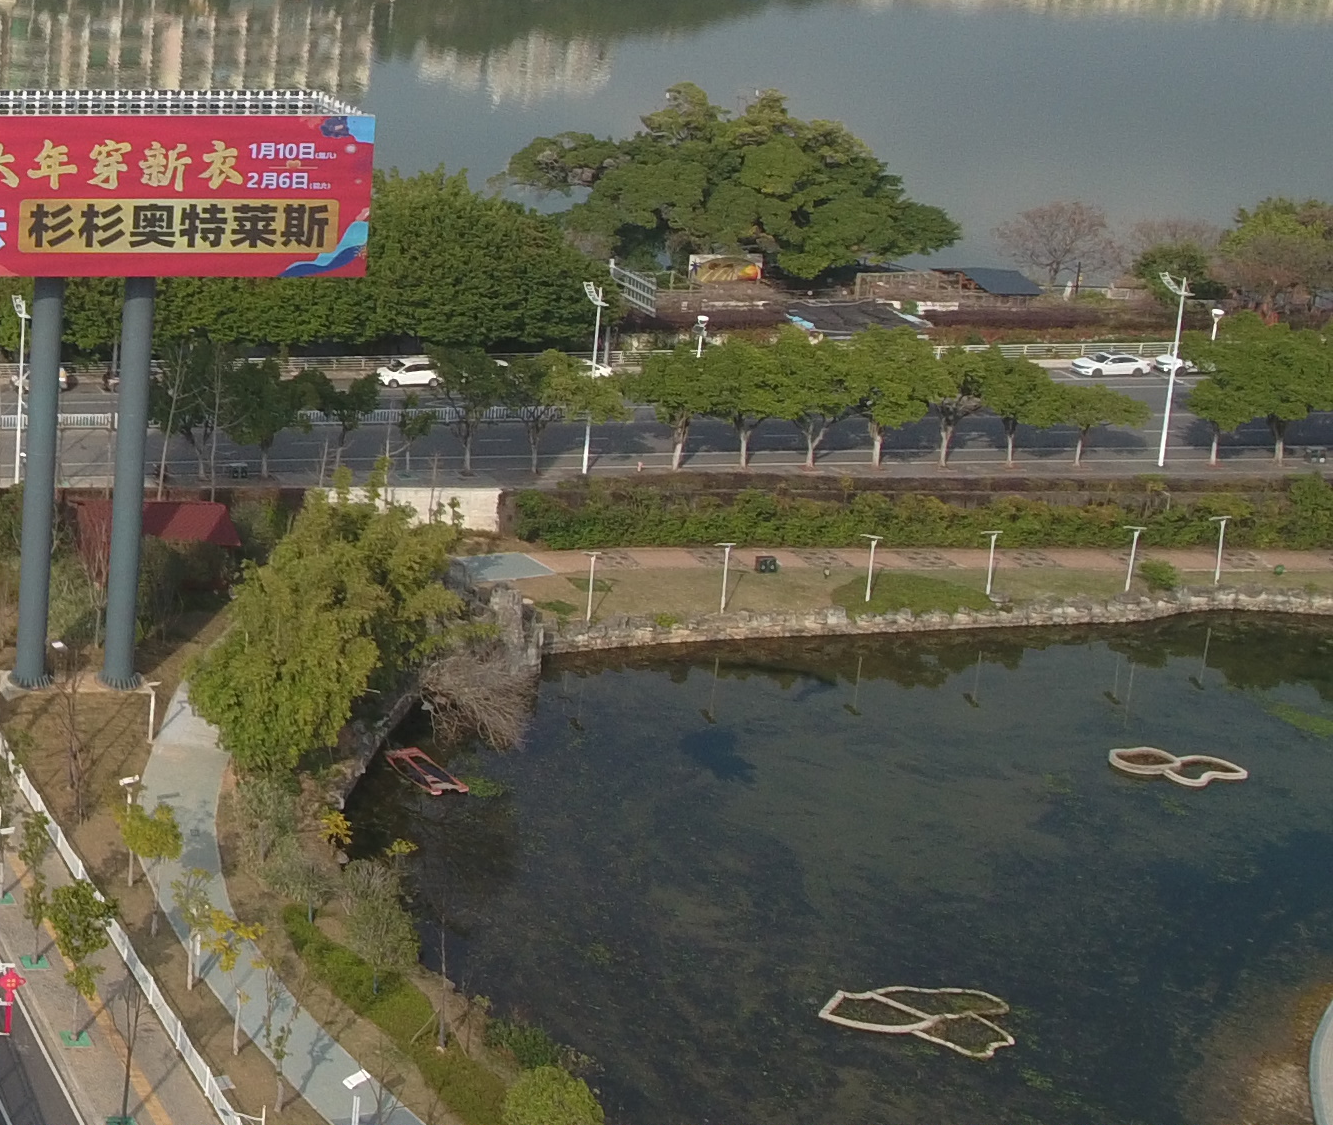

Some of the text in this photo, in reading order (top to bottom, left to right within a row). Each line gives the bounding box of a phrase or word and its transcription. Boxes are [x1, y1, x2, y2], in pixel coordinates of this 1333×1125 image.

[248, 142, 315, 159] 1月10日
[247, 172, 308, 189] 2月6日
[29, 204, 330, 249] 杉杉奥特莱斯
